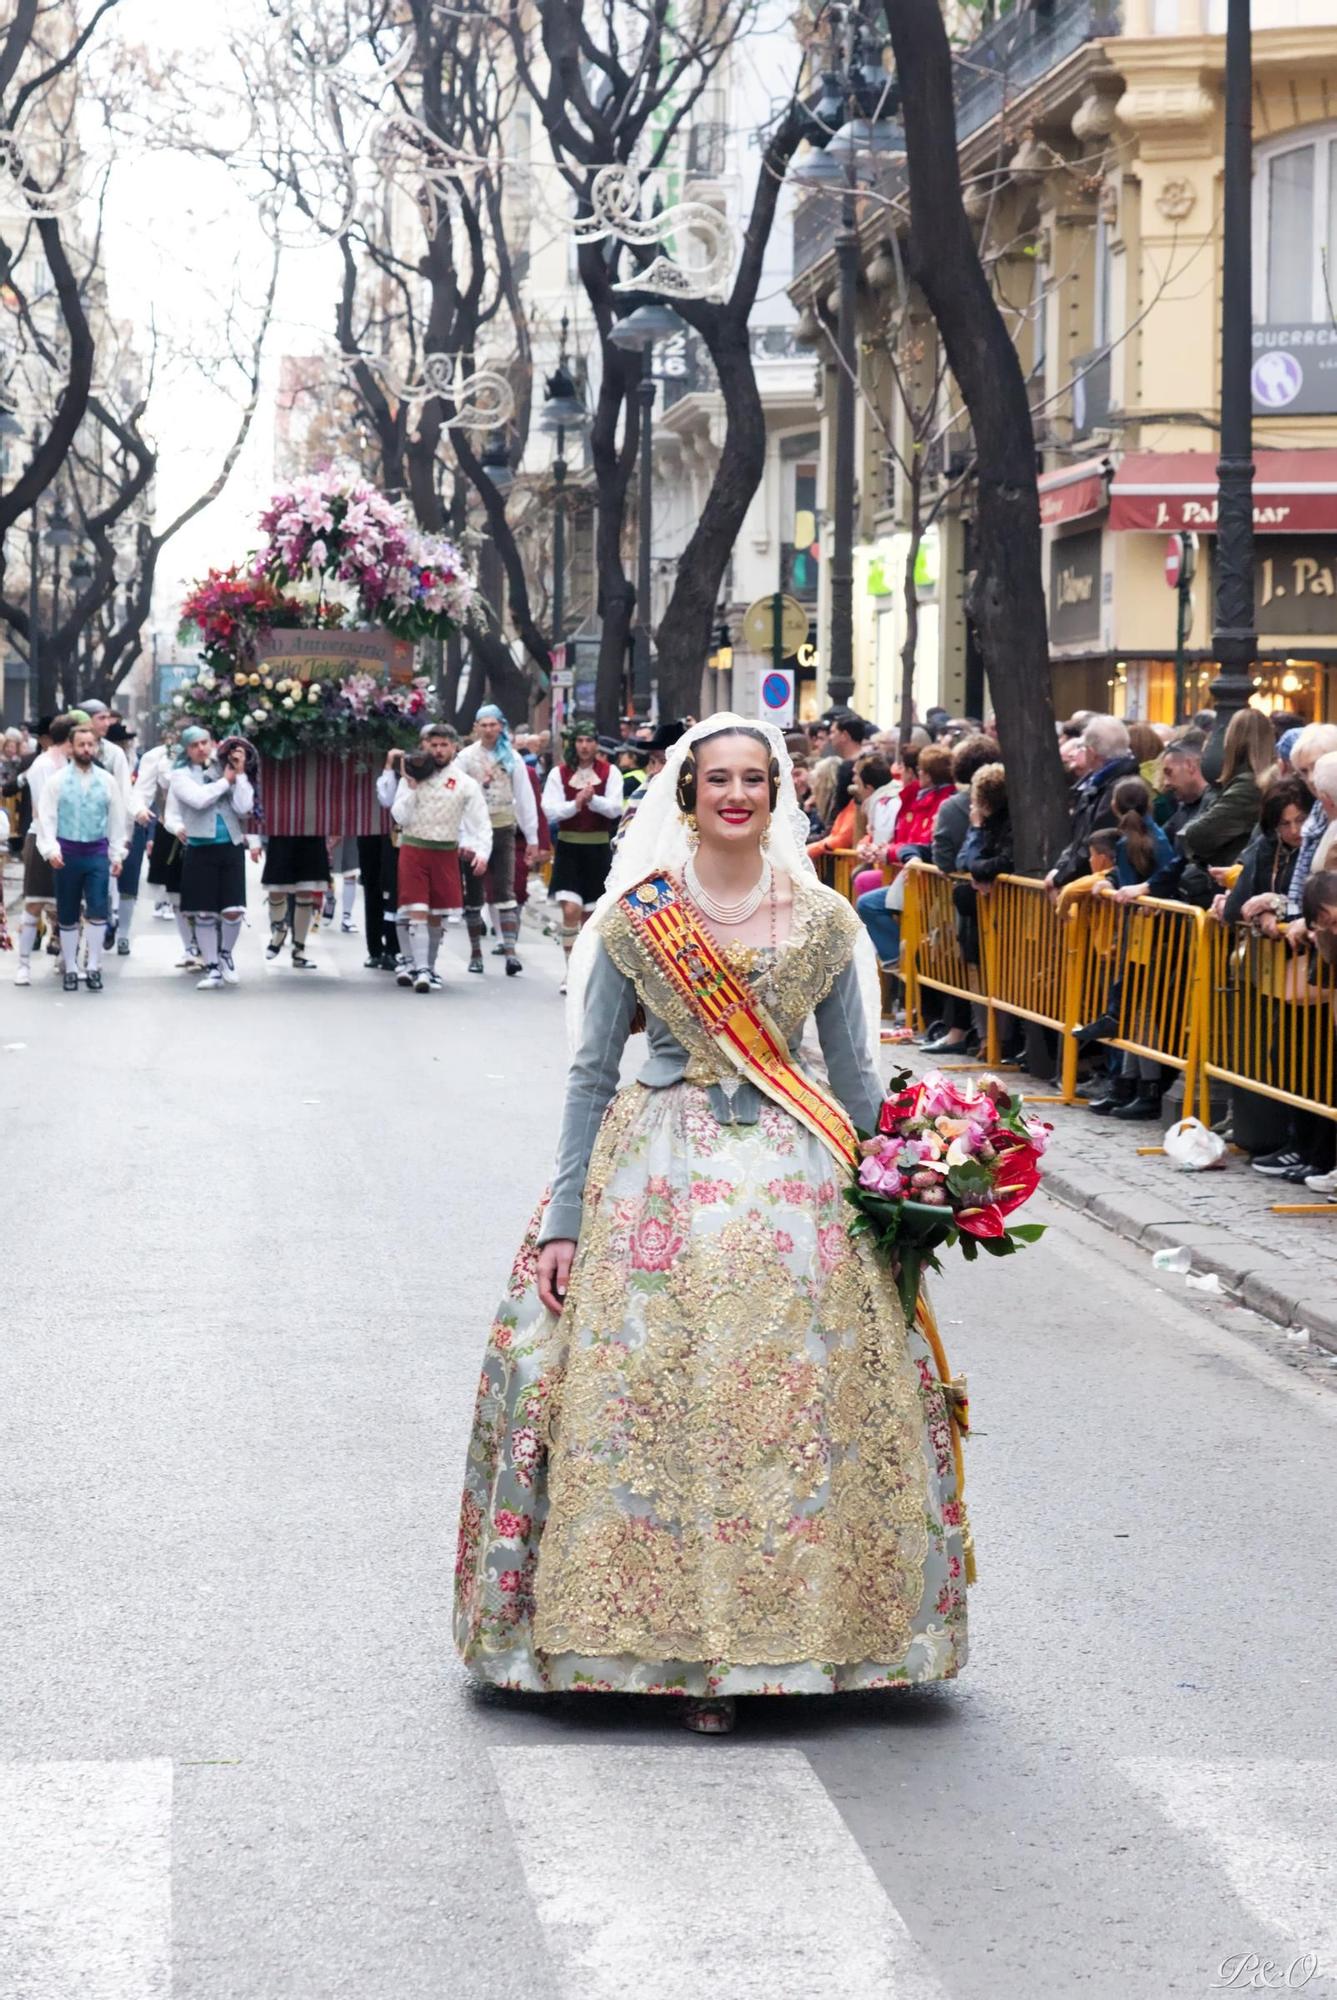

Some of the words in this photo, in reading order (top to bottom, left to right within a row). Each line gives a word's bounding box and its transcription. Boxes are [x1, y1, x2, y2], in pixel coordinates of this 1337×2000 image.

[1156, 502, 1170, 528] J.
[1182, 500, 1290, 524] Palar
[1261, 558, 1286, 606] J.
[1292, 557, 1337, 596] Pa
